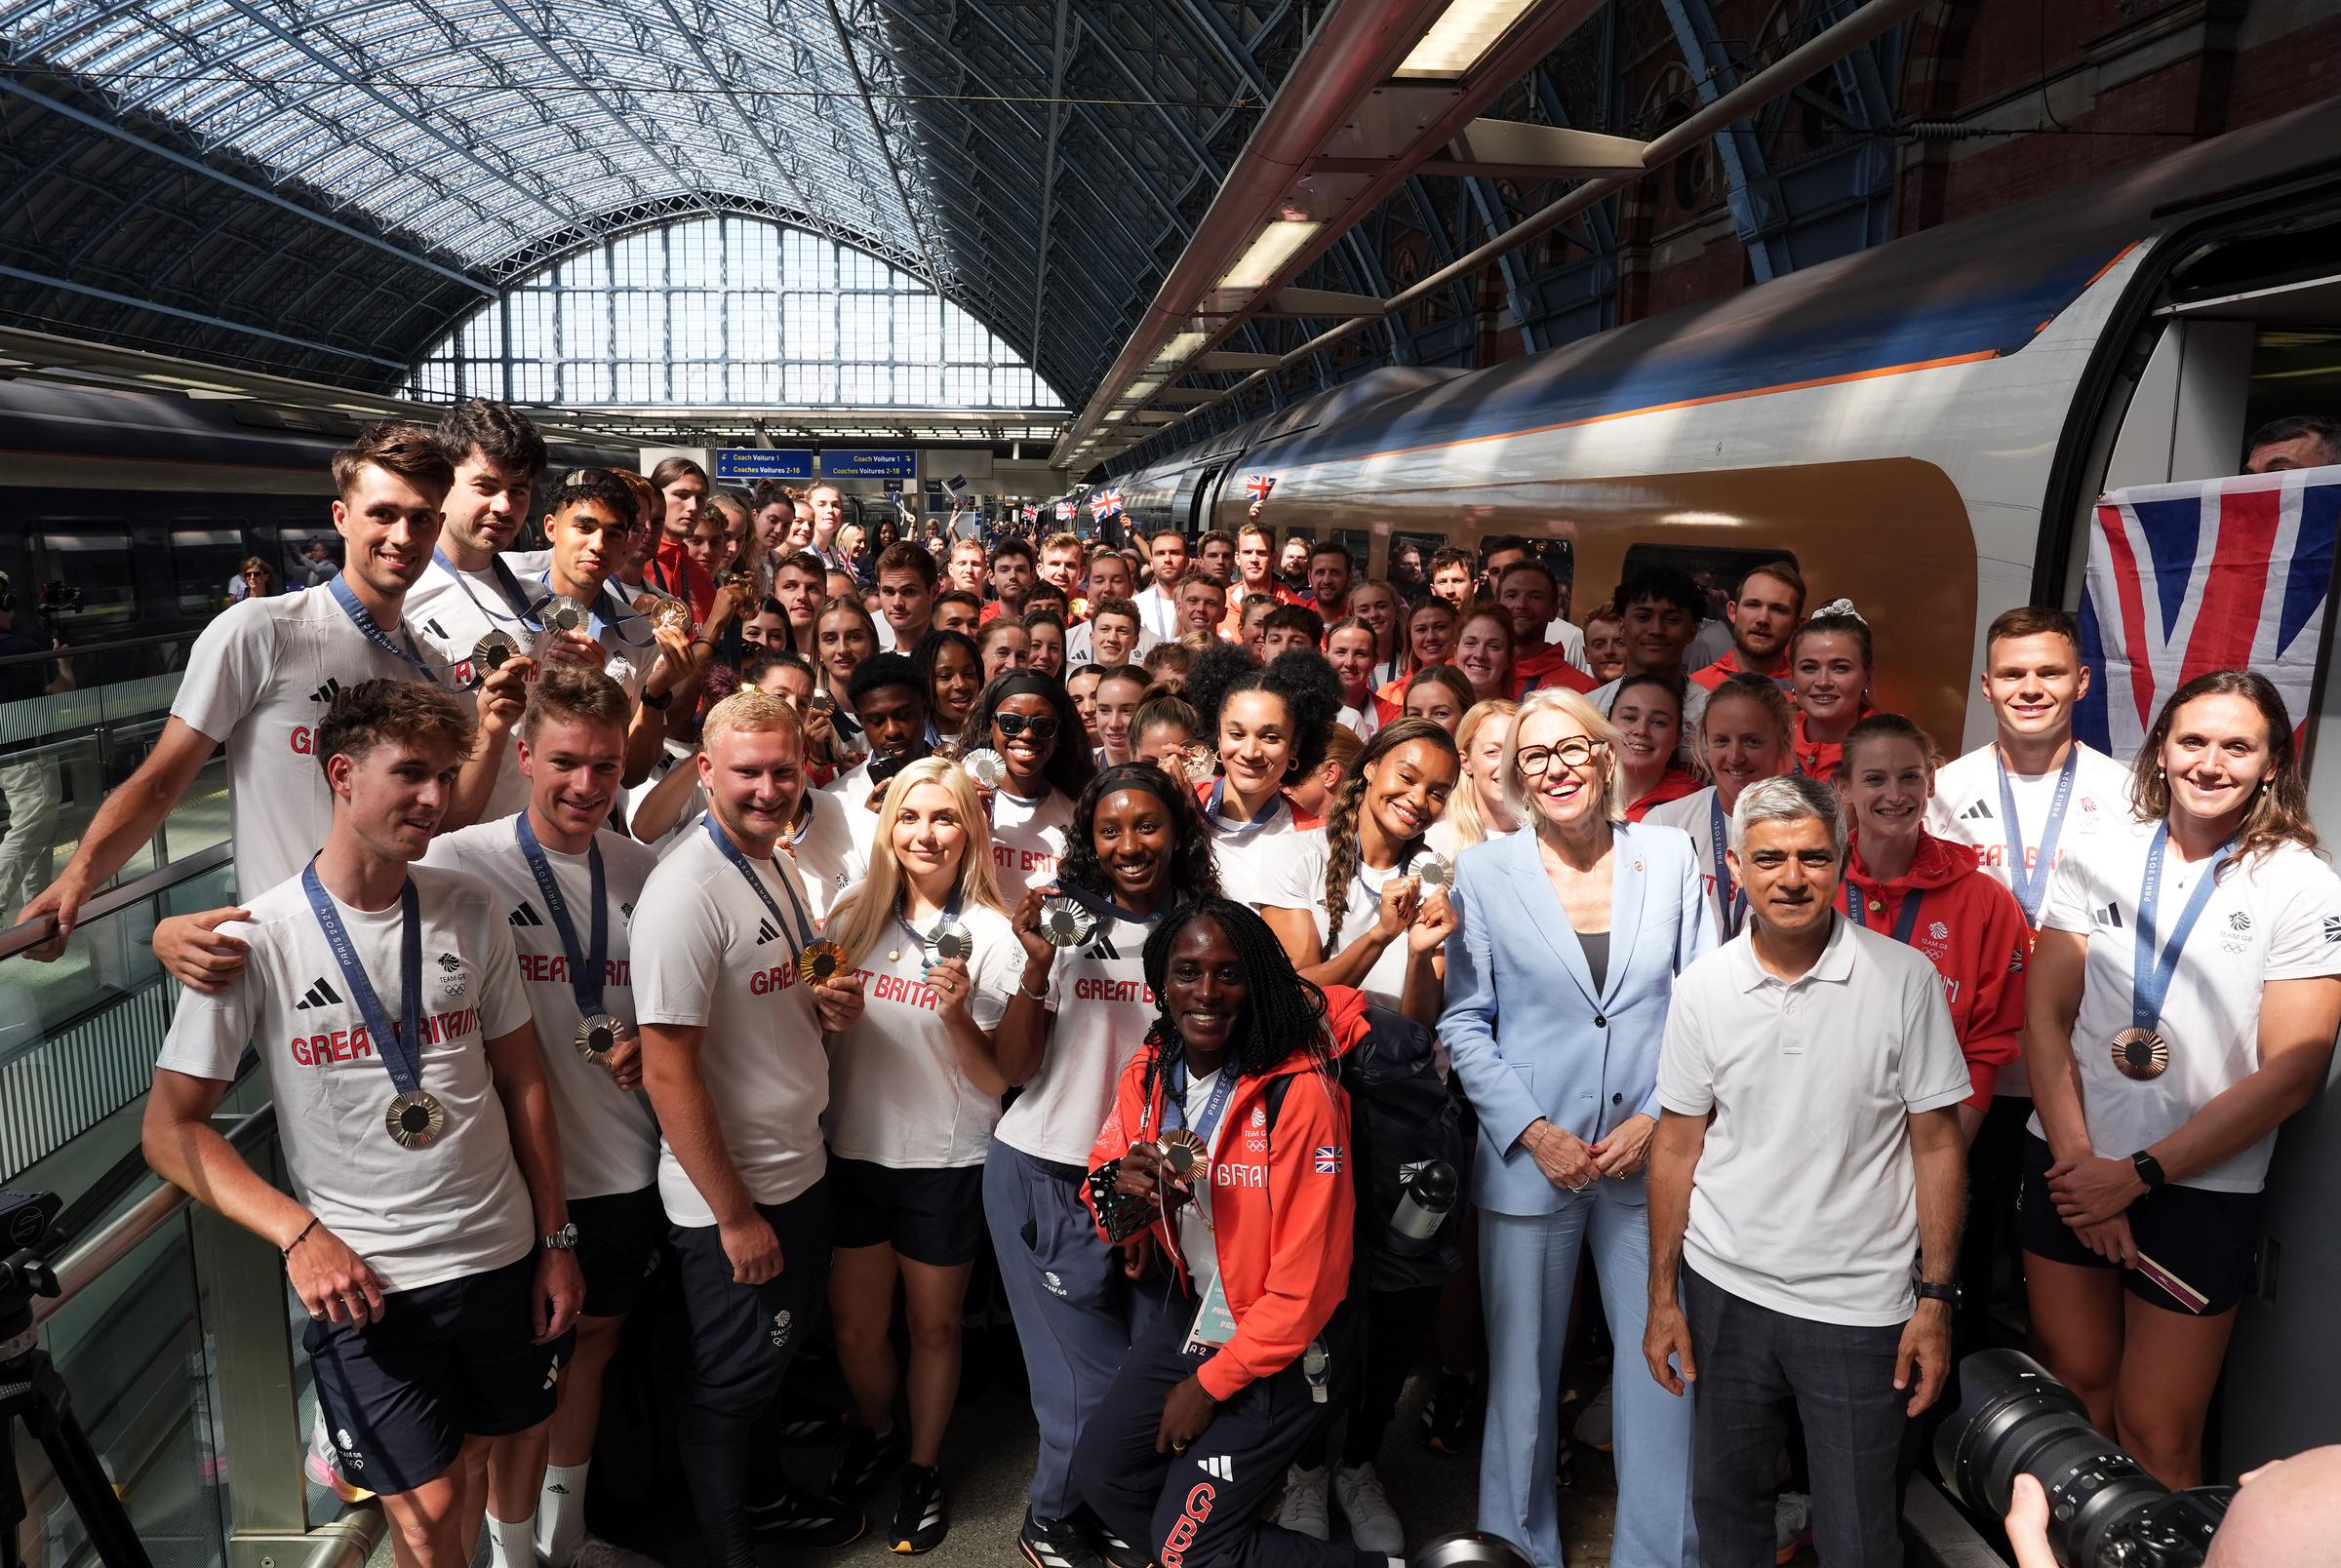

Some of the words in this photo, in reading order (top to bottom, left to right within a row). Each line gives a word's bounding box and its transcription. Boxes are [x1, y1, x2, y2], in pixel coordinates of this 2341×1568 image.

[2051, 794, 2065, 818] PARIS
[2059, 771, 2071, 794] 2024
[534, 858, 547, 884] 2024
[2148, 849, 2159, 874] 2024
[544, 884, 562, 912] PARIS
[753, 882, 773, 905] PARIS
[2144, 872, 2156, 902] PARIS
[320, 908, 338, 935] 2024
[2219, 930, 2240, 940] TEAM
[333, 937, 352, 966] PARIS
[1921, 938, 1938, 947] TEAM
[439, 974, 456, 984] TEAM
[874, 973, 939, 1011] BRITA
[1075, 978, 1139, 1002] GREAT
[292, 1026, 373, 1066] GREA
[1208, 1087, 1224, 1116] PARIS
